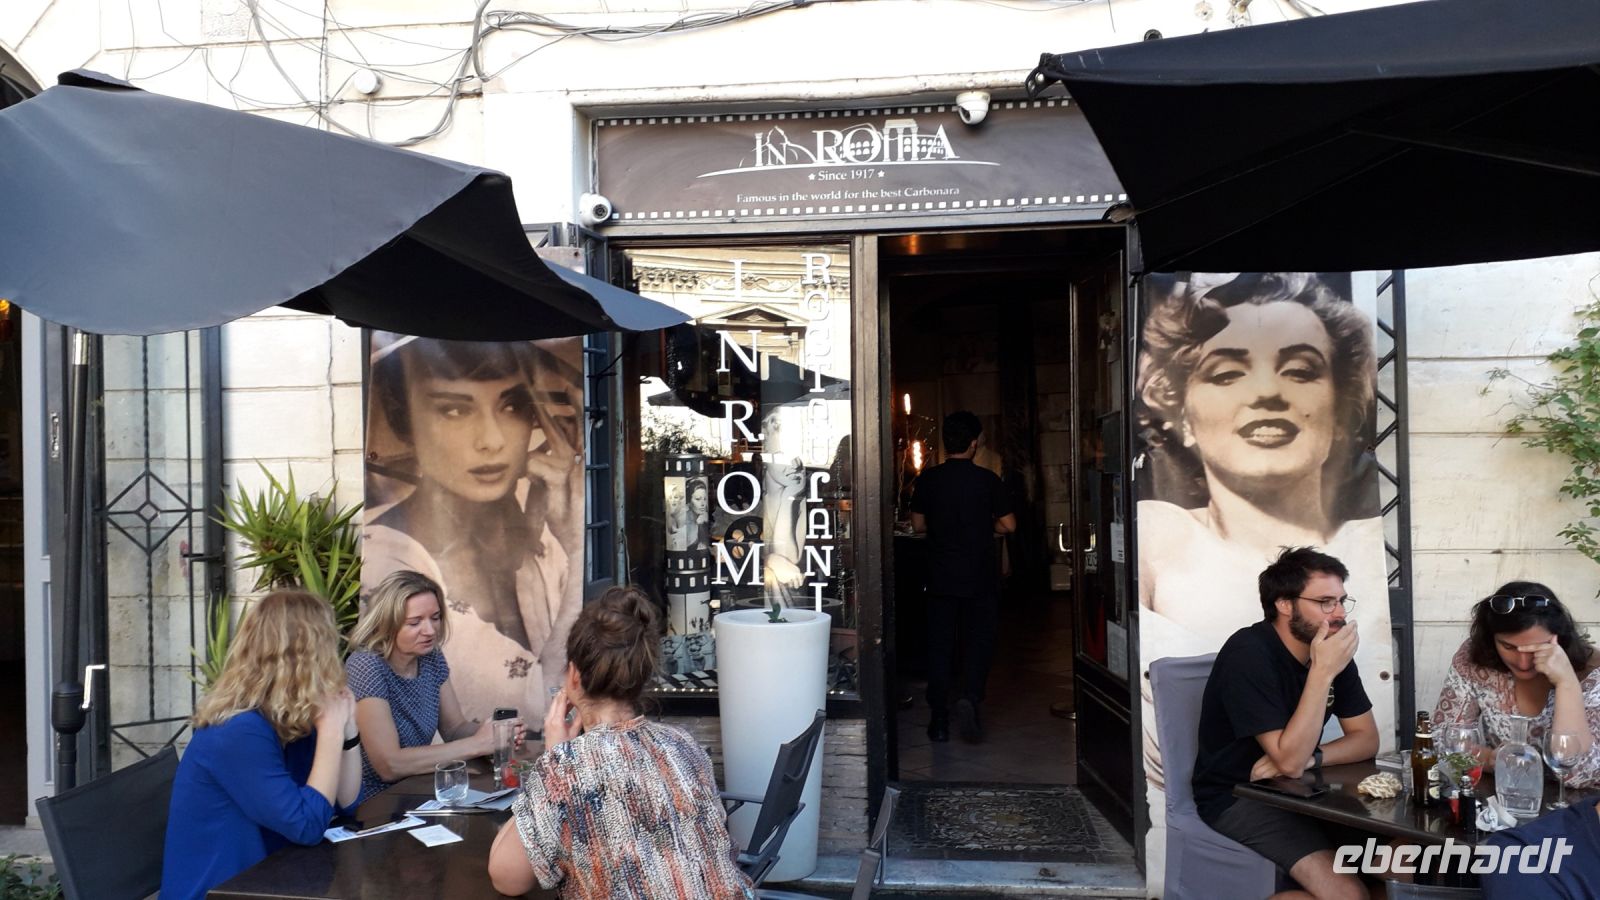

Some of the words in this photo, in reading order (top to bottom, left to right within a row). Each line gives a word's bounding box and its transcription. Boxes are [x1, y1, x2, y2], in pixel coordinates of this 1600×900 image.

[754, 132, 787, 167] IN
[812, 119, 960, 164] ROMA
[817, 170, 847, 181] Since
[850, 169, 875, 181] 1917
[736, 193, 777, 204] Famous
[779, 193, 790, 203] in
[792, 192, 808, 202] the
[810, 190, 841, 201] world
[844, 189, 859, 200] for
[861, 189, 879, 199] the
[880, 188, 902, 198] best
[904, 186, 960, 197] Carbonara
[711, 400, 765, 586] ROM
